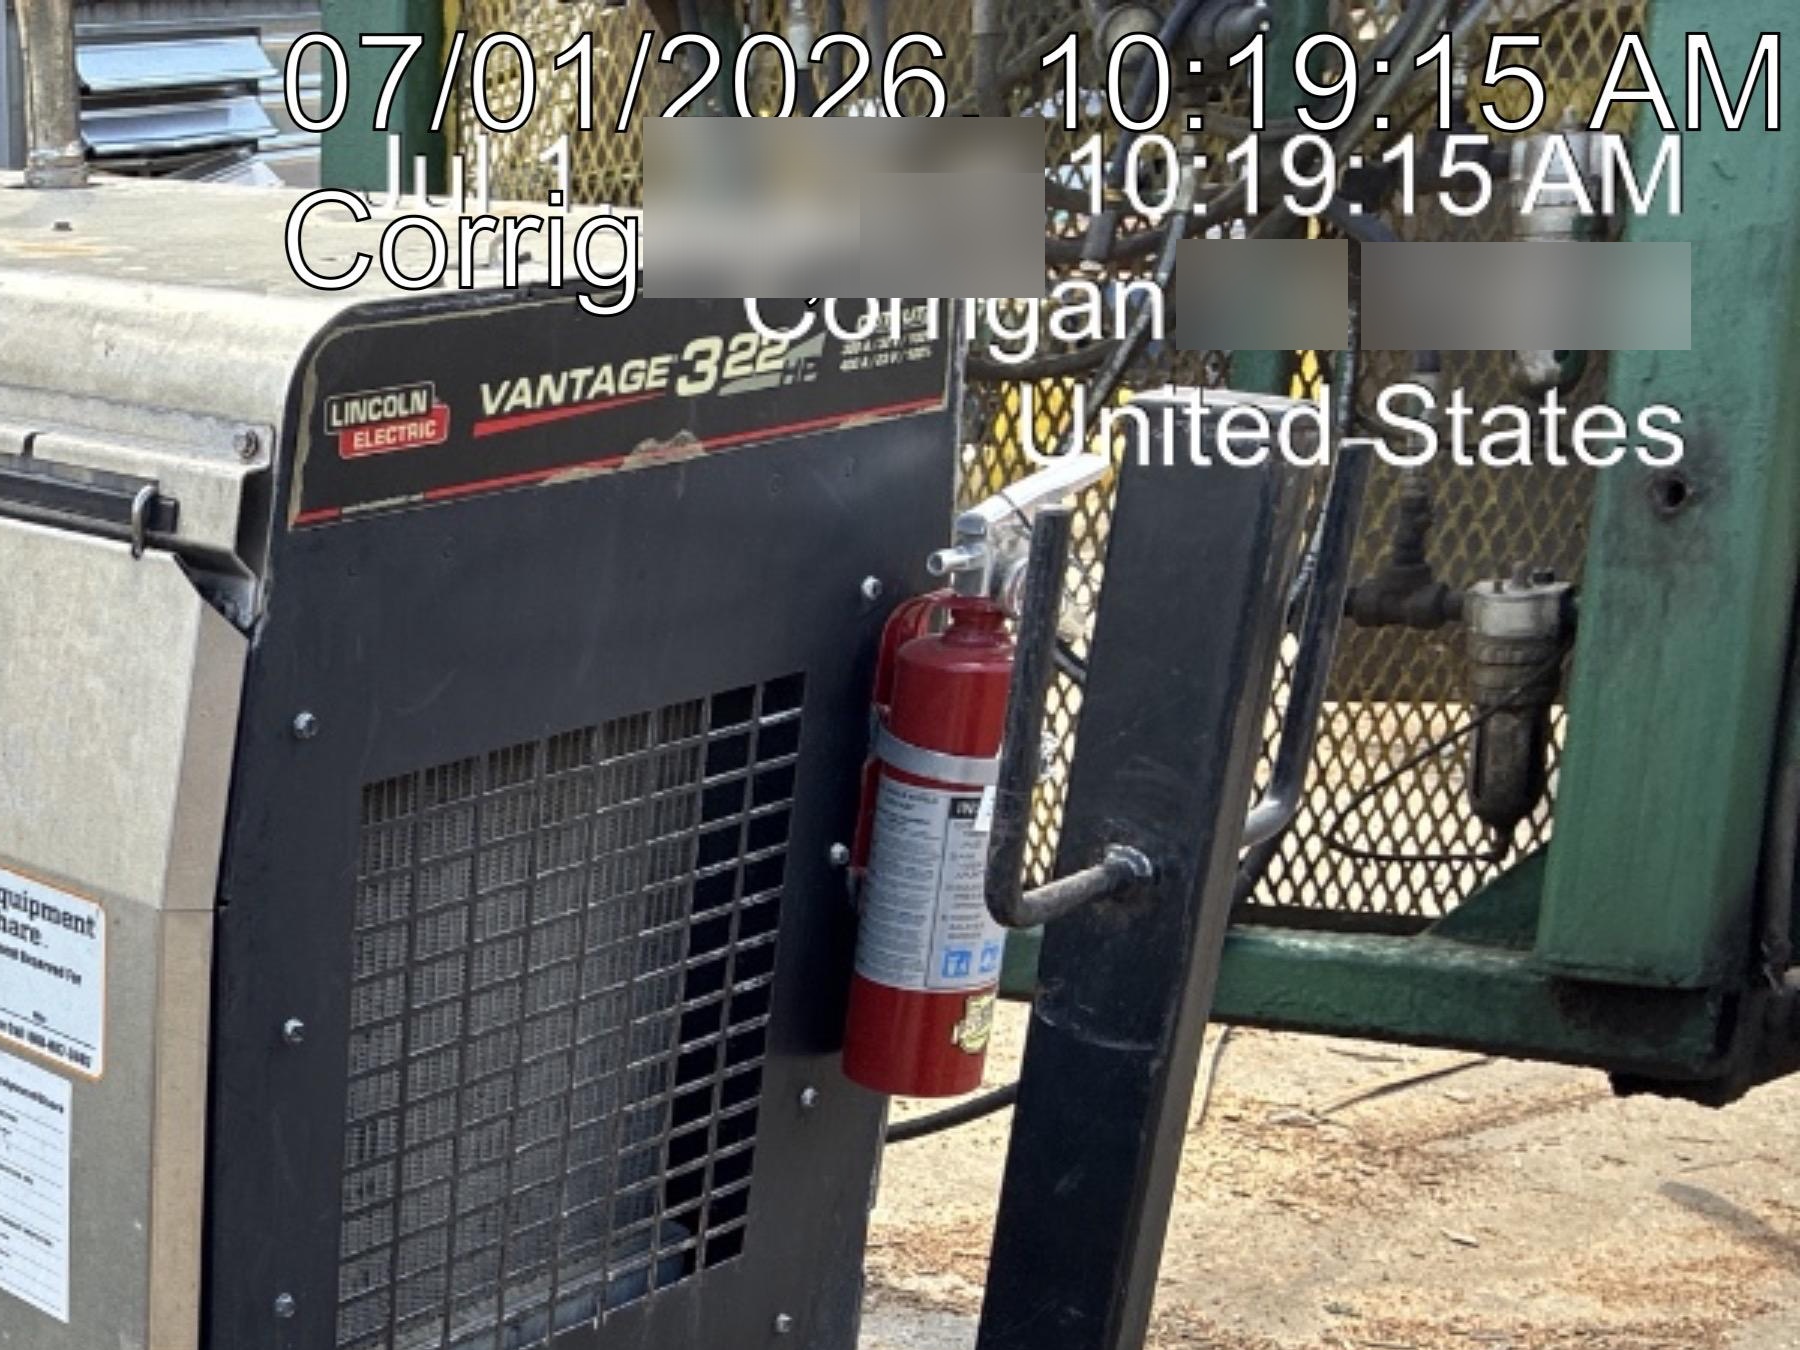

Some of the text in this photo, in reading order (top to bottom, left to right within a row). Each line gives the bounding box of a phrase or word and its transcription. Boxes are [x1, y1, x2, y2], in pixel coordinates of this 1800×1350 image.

[478, 354, 671, 417] VANTAGE
[331, 388, 429, 429] LINCOLN
[353, 419, 437, 451] ELECTRIC
